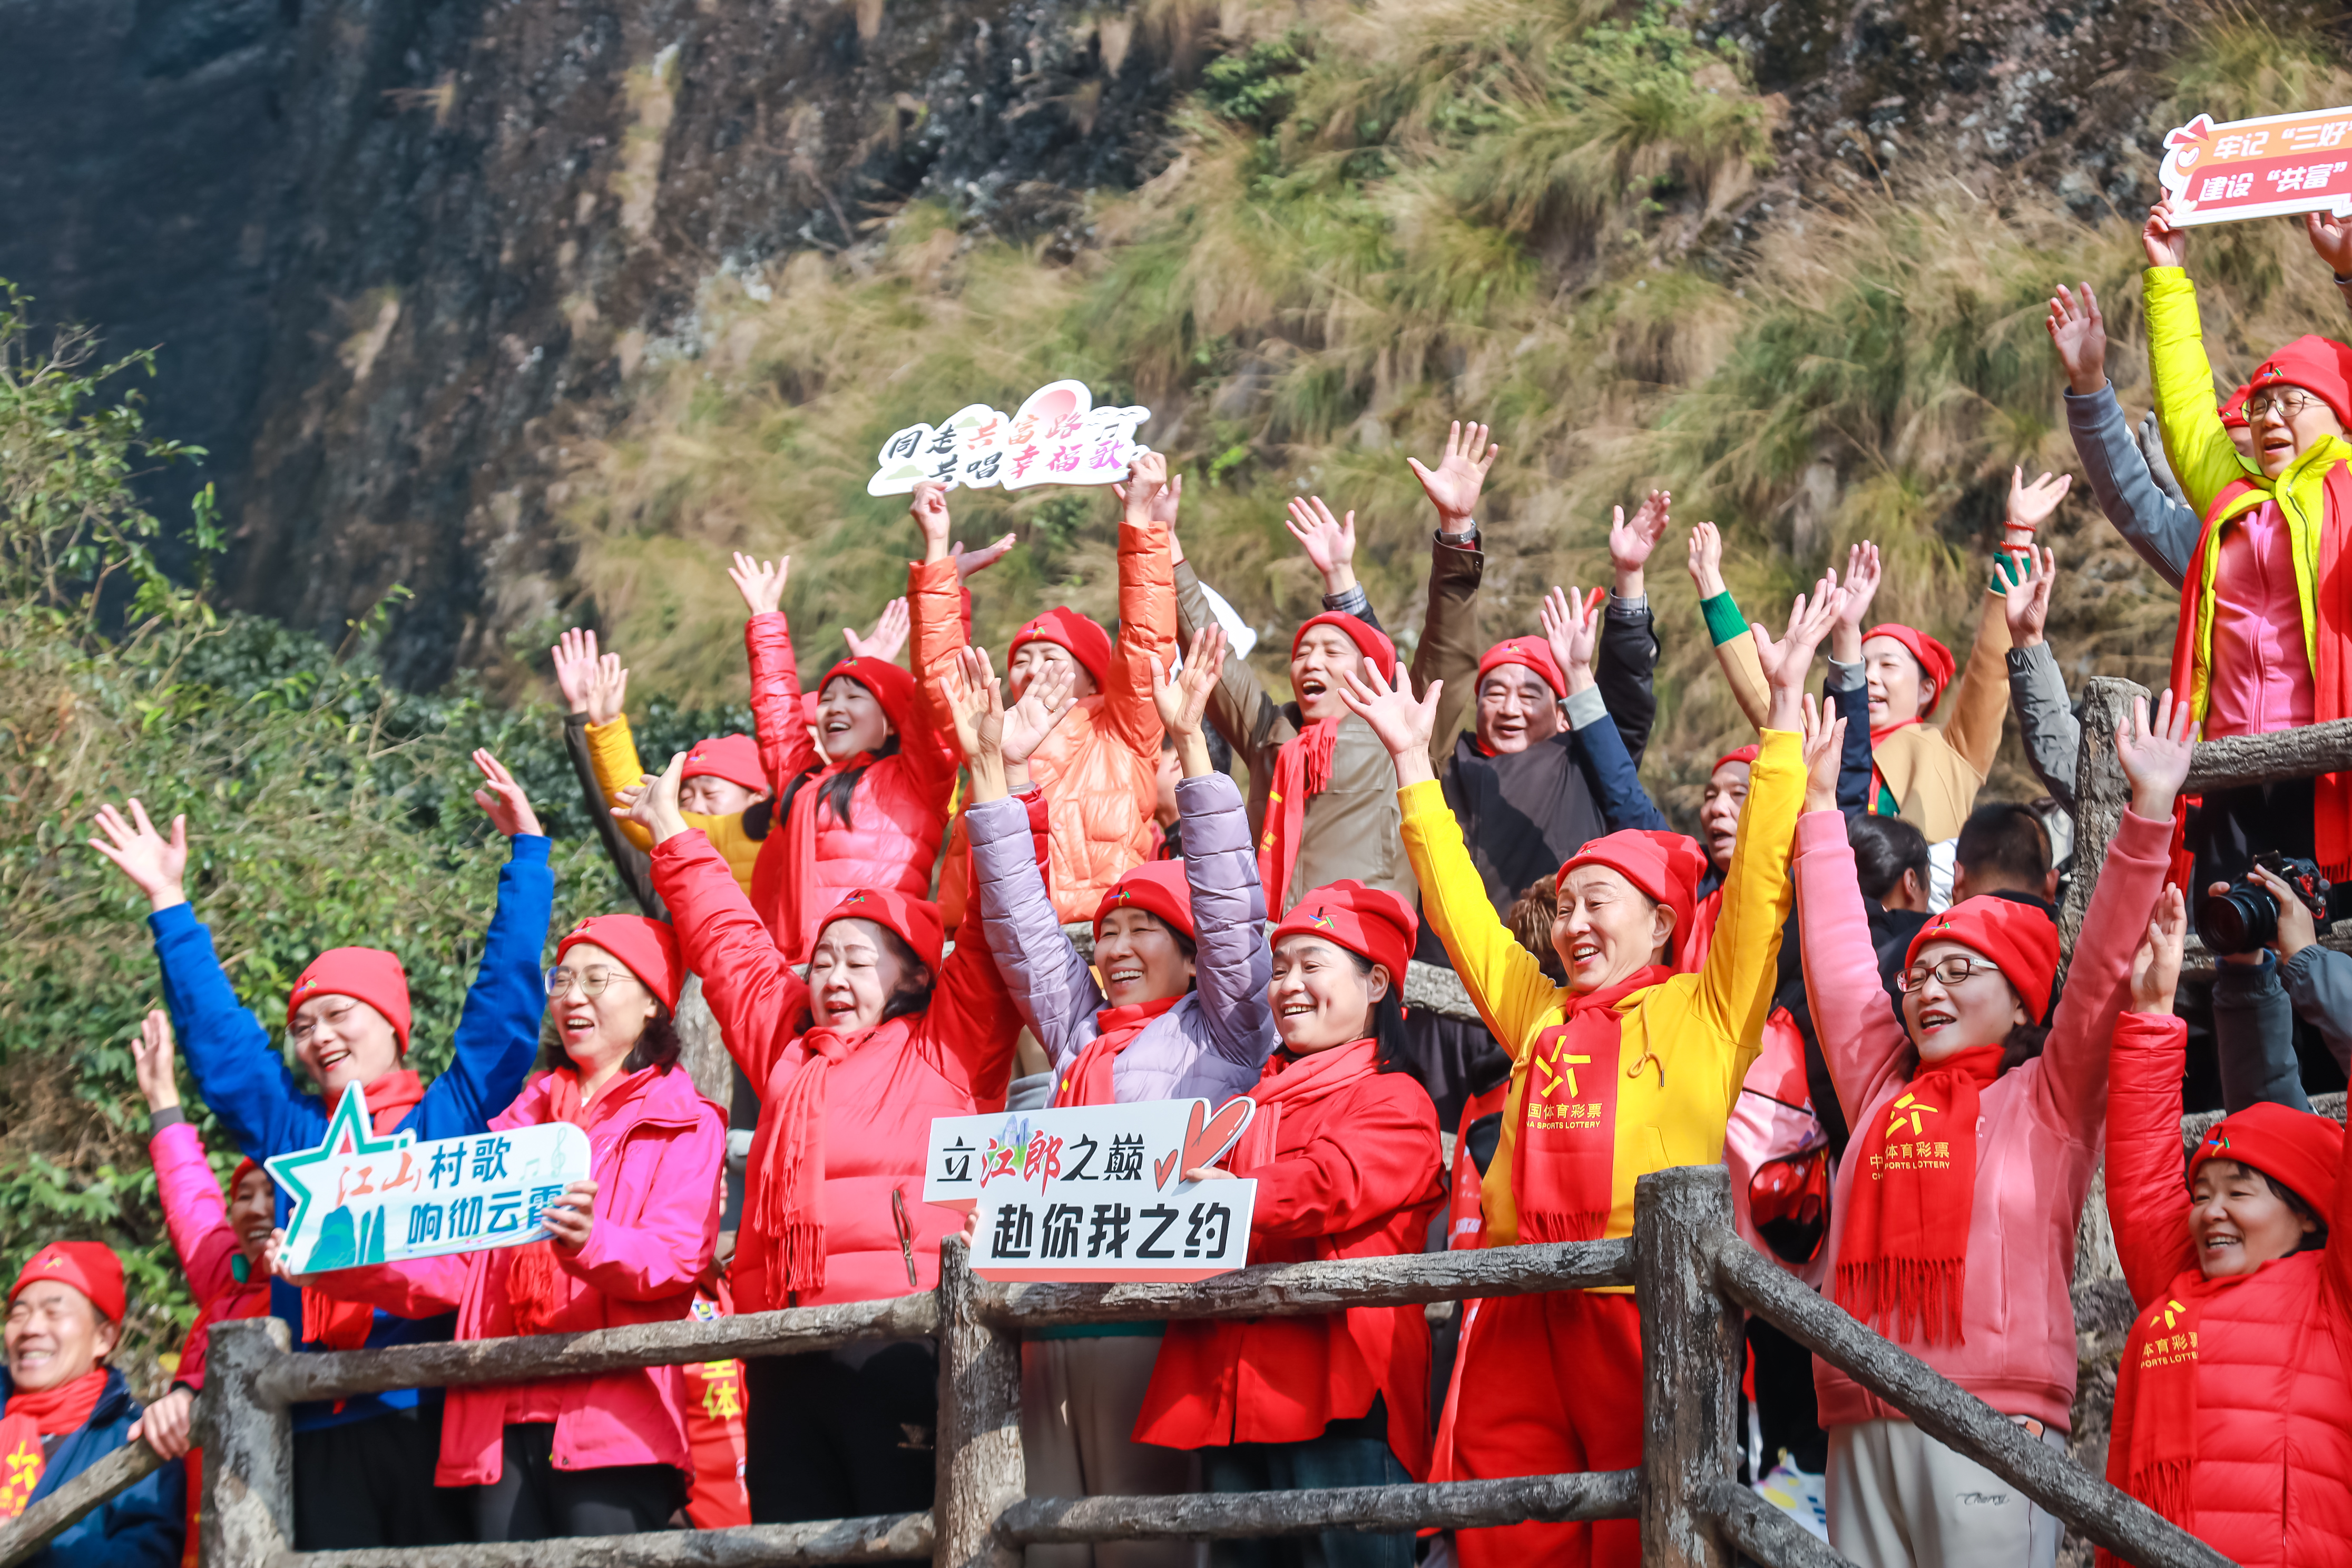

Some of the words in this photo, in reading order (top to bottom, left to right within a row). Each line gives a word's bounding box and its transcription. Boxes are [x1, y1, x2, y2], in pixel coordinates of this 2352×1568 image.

[888, 411, 1083, 459] 同走共富路
[928, 439, 1125, 482] 共唱幸福歌
[1527, 1102, 1603, 1120] 国体育彩票
[1565, 1120, 1601, 1129] LOTTERY
[337, 1136, 512, 1207] 江山村歌
[936, 1129, 1145, 1198] 立江郎之巅
[1913, 1160, 1950, 1170] LOTTERY
[991, 1201, 1231, 1259] 赴你我之约
[2170, 1351, 2199, 1364] LOTTE
